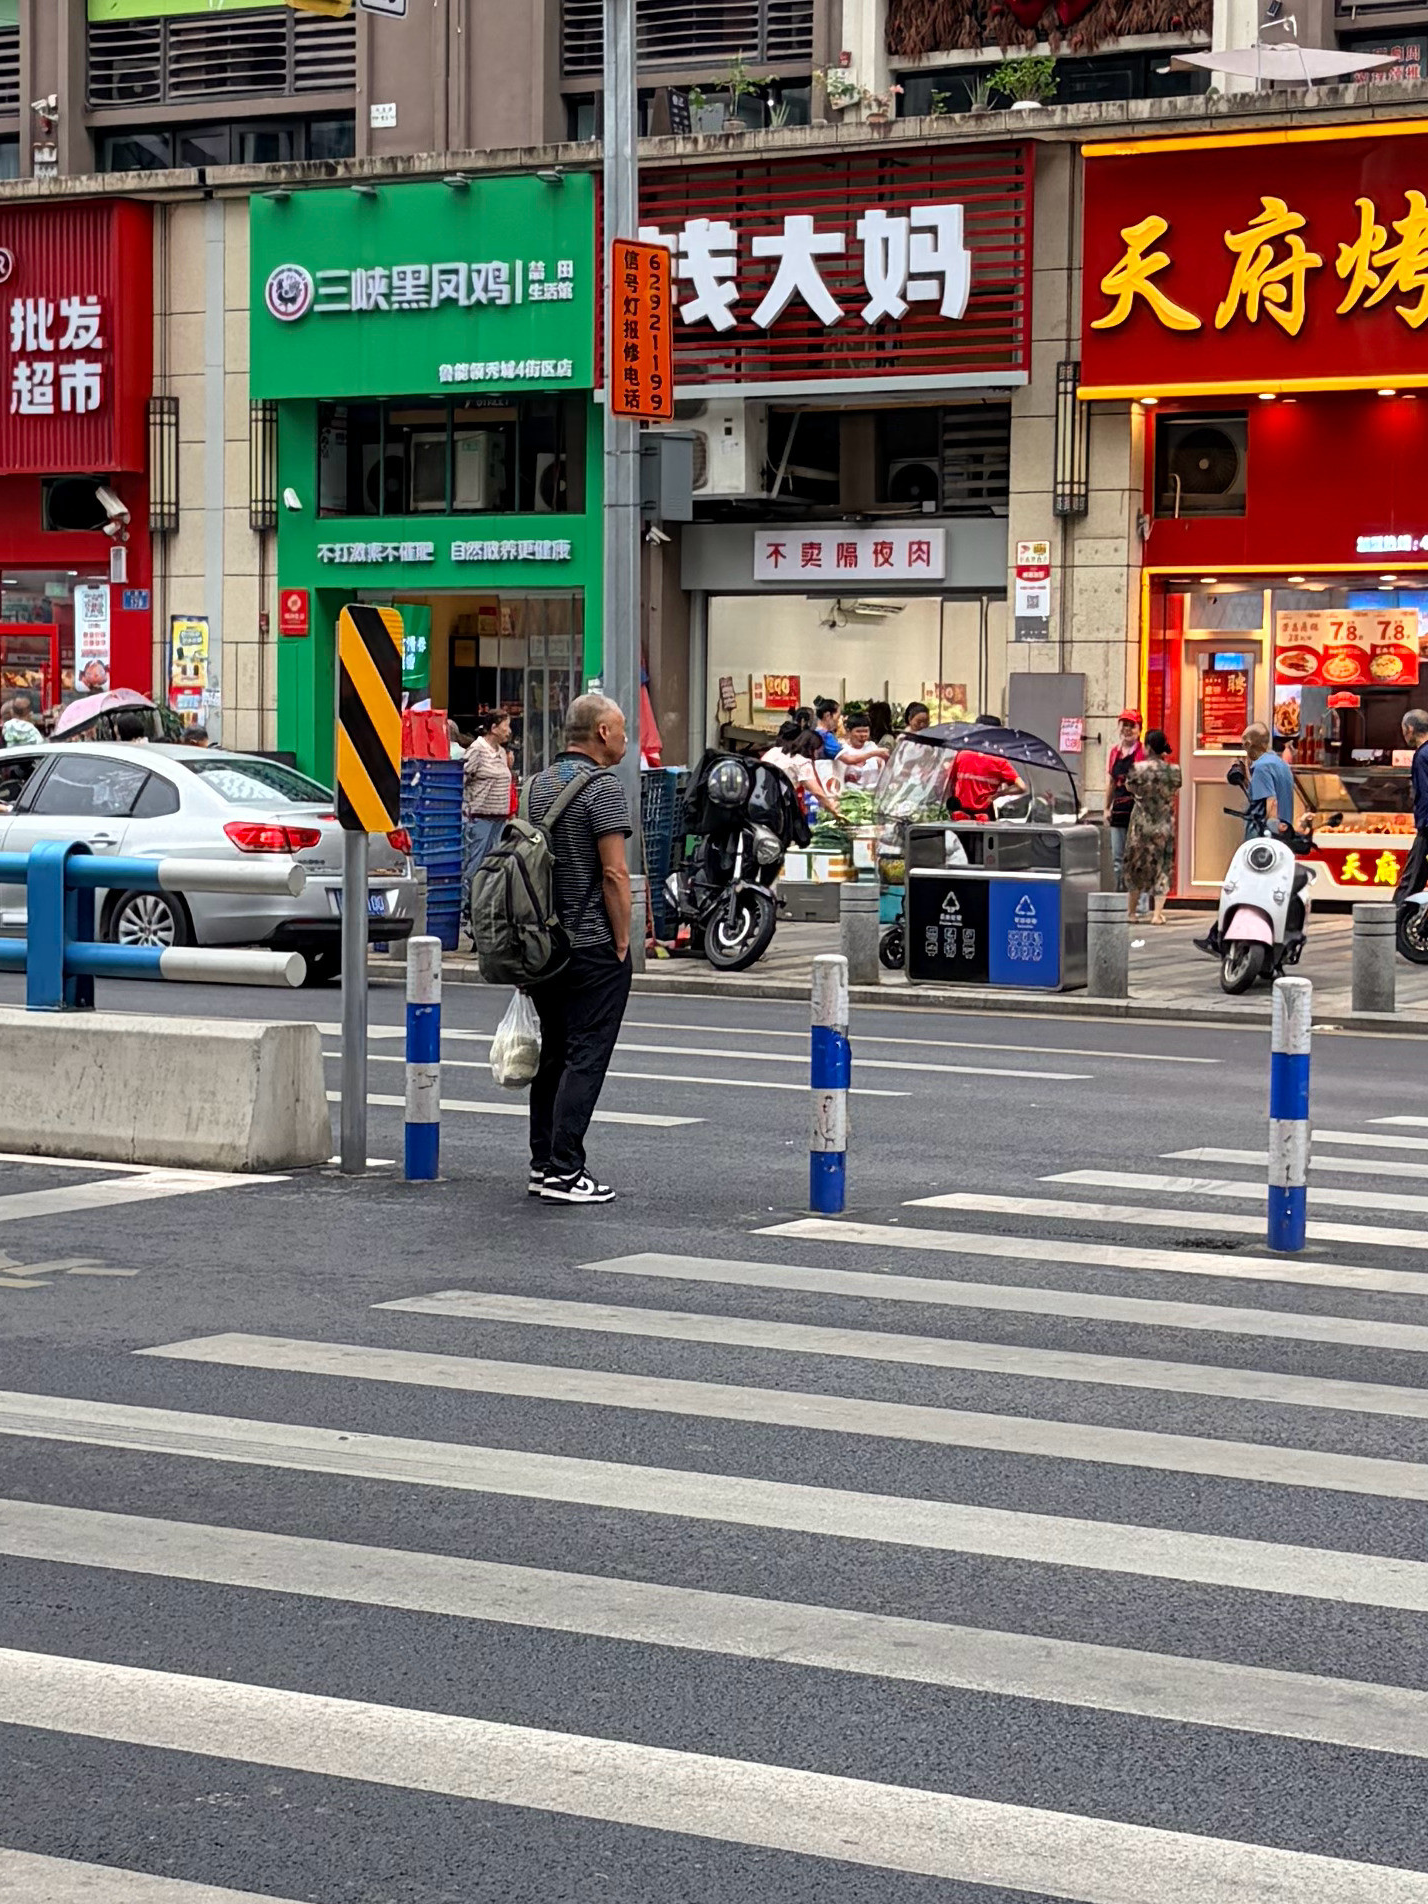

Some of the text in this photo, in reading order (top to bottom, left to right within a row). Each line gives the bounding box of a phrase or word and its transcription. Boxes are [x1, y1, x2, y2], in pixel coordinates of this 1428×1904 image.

[313, 259, 510, 313] 三峡黑凤鸡
[9, 295, 105, 354] 批发
[622, 249, 641, 411] 信号灯报修电话
[648, 253, 664, 411] 62921199
[9, 358, 104, 416] 超市
[765, 539, 932, 569] 不卖隔夜肉
